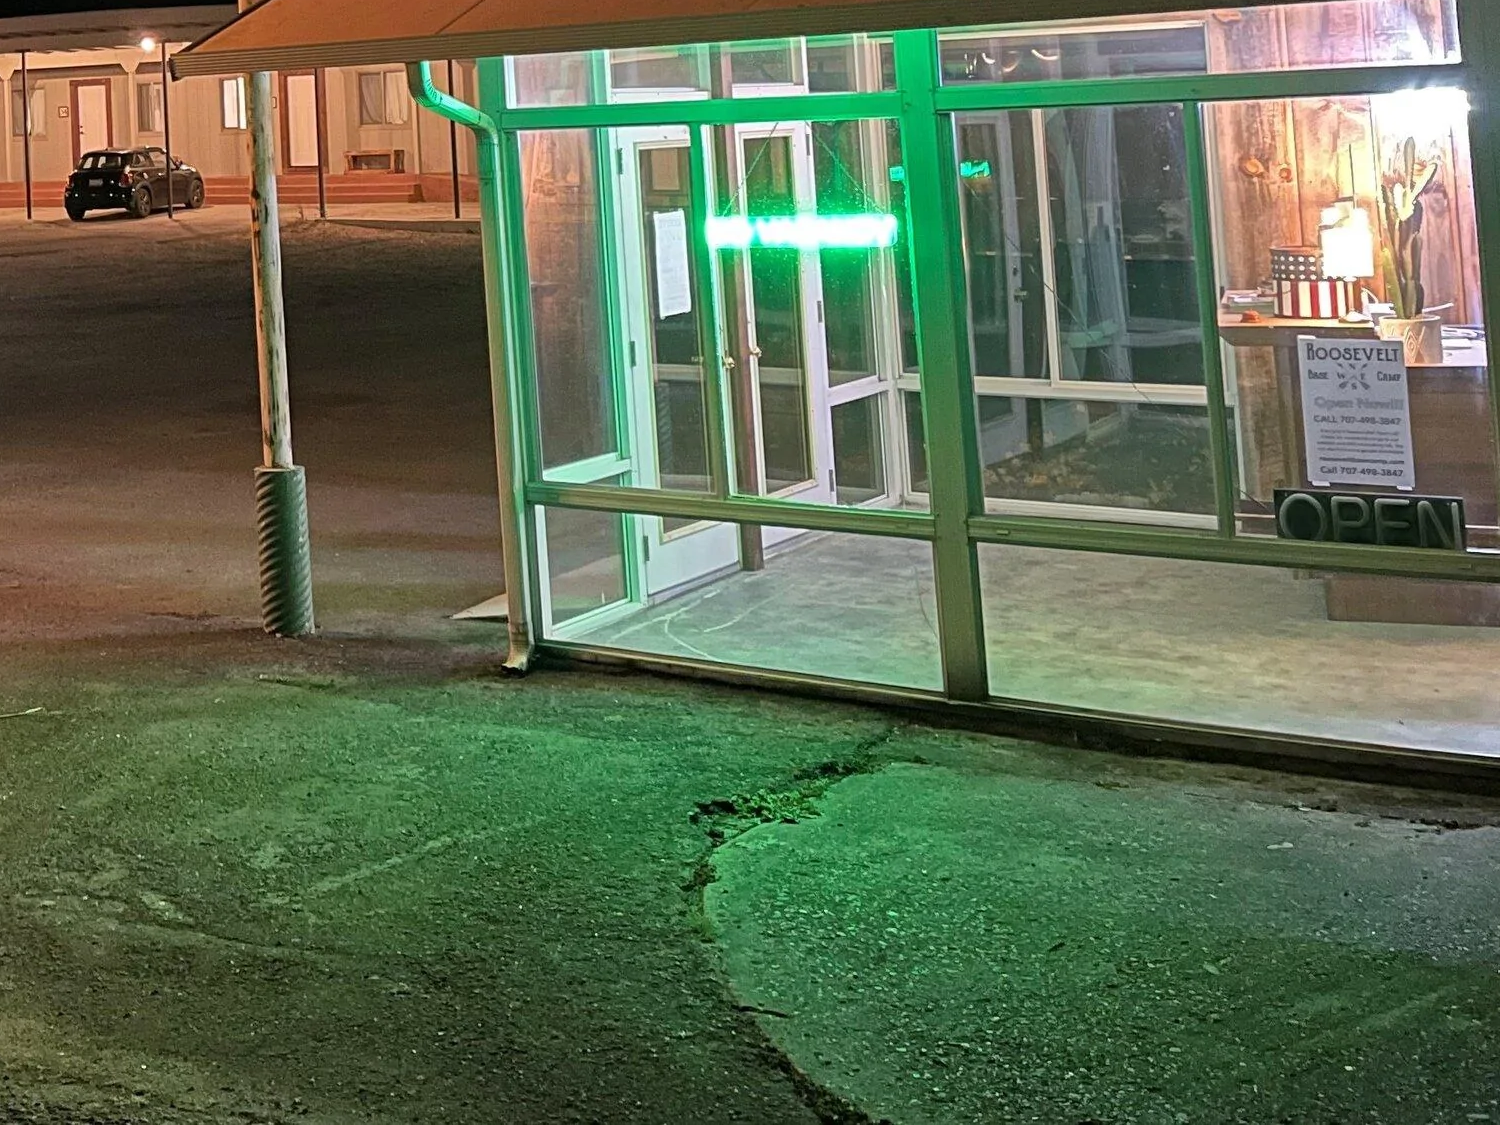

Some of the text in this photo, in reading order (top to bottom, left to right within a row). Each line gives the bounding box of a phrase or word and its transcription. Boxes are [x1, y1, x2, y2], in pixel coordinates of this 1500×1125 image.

[1306, 342, 1400, 362] ROOSEVELT
[1376, 370, 1402, 382] CAMP
[1313, 414, 1338, 424] CALL
[1320, 465, 1338, 475] Call
[1279, 493, 1463, 550] OPEN
